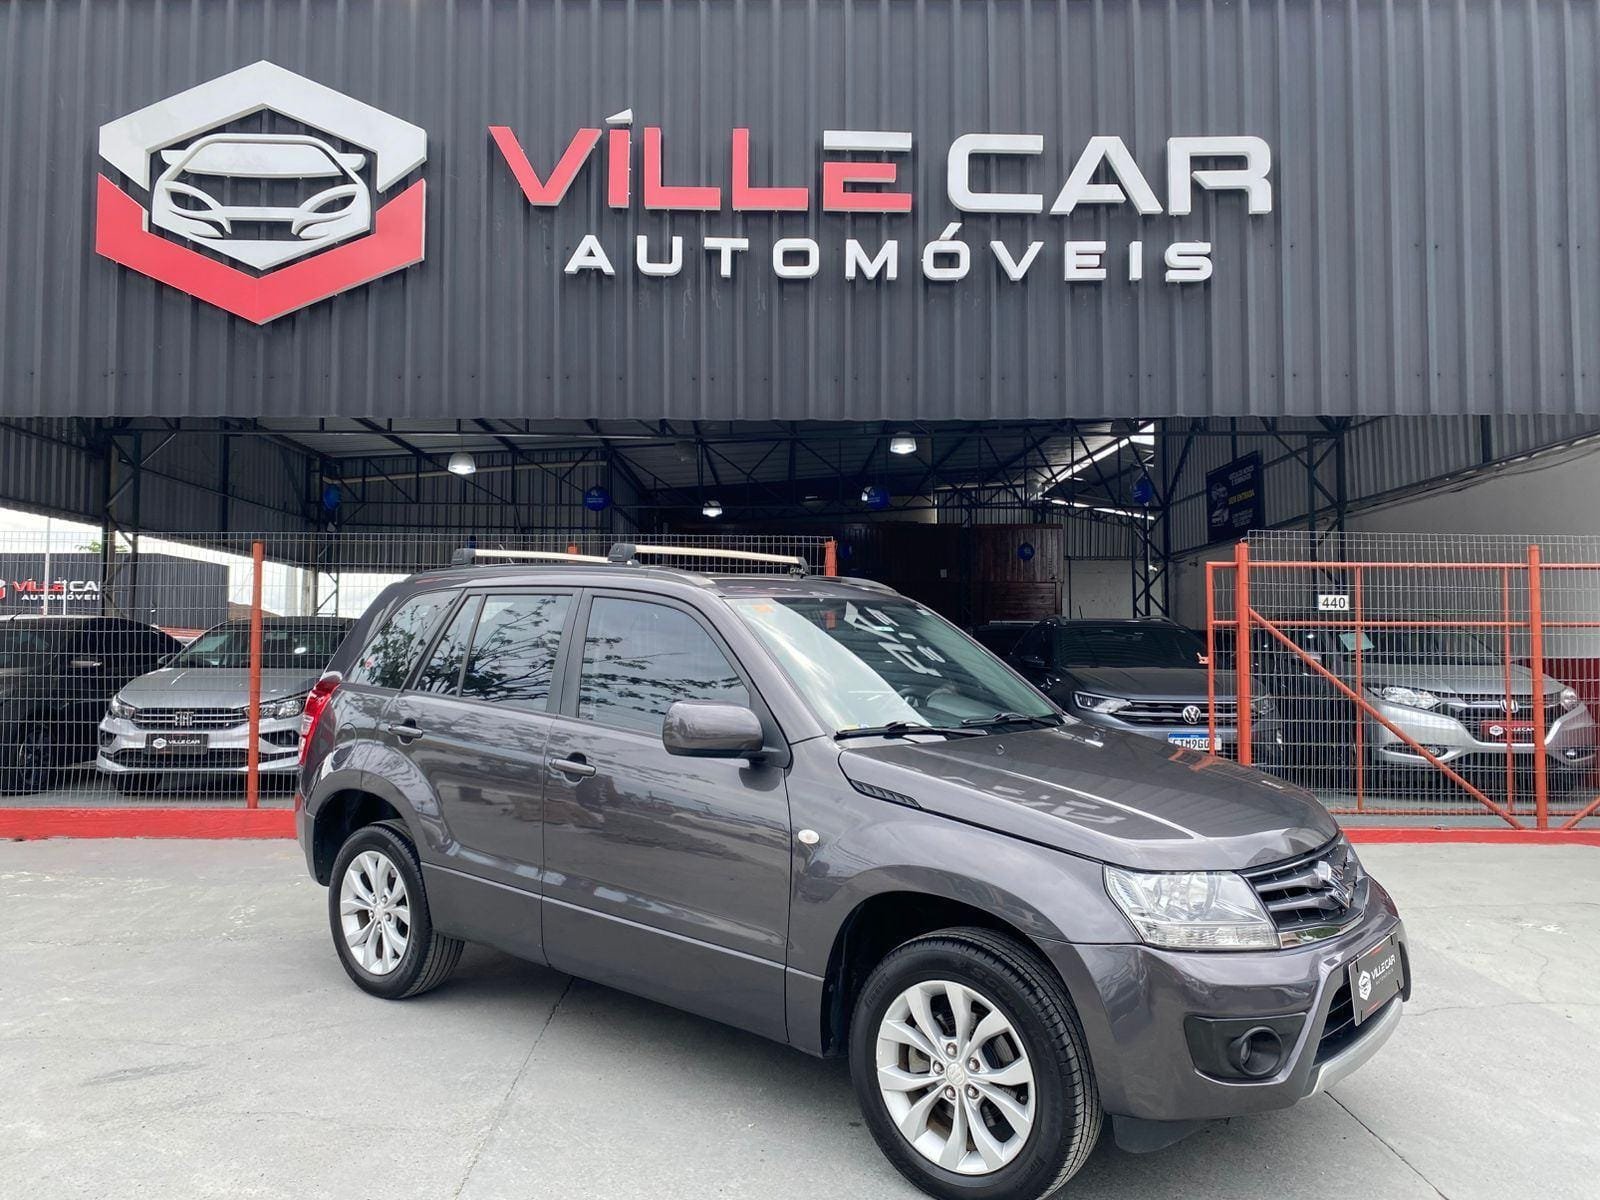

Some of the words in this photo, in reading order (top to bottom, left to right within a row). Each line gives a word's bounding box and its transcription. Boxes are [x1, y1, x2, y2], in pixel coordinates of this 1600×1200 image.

[488, 107, 913, 214] VÍLLE
[946, 133, 1273, 217] CAR
[563, 222, 1213, 284] AUTOMÓVEIS
[69, 580, 100, 592] CA
[1321, 597, 1346, 609] 440
